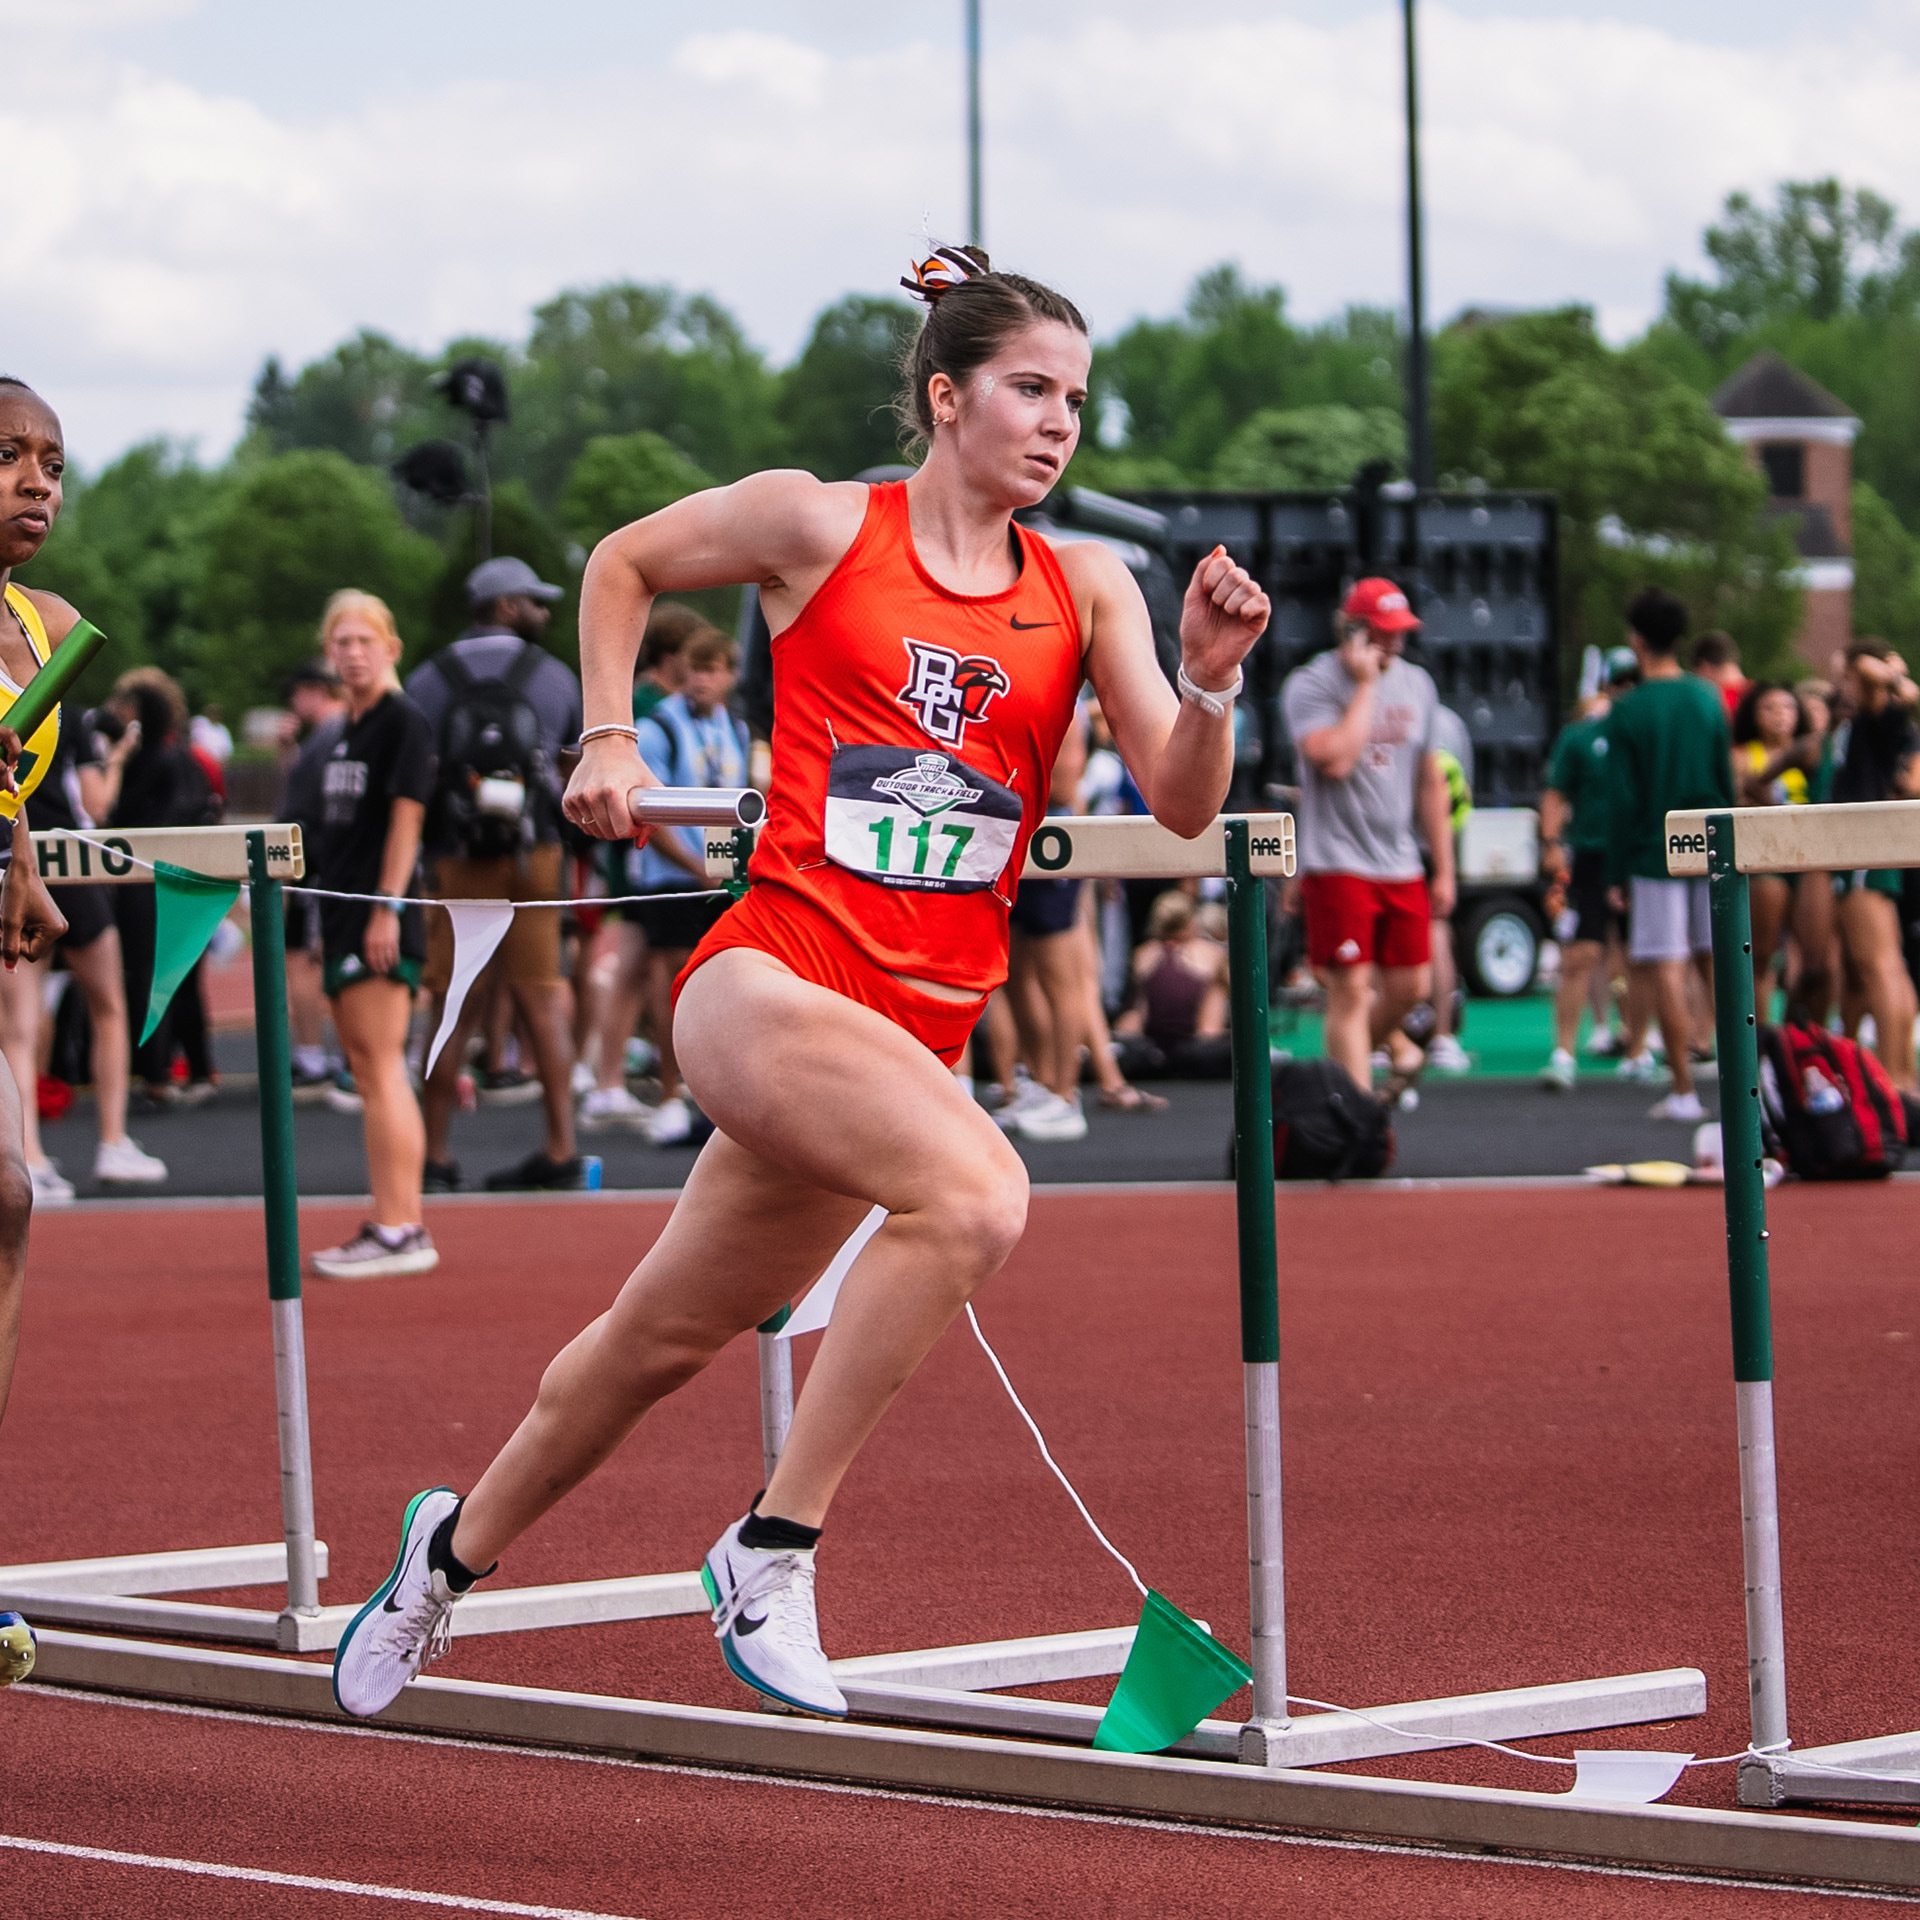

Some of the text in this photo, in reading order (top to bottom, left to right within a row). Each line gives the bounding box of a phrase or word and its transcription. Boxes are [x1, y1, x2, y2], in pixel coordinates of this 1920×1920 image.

[876, 779, 918, 792] OUTDOOR
[919, 784, 948, 796] TRACK
[947, 788, 955, 796] &
[955, 789, 980, 799] FIELD
[868, 816, 975, 877] 117
